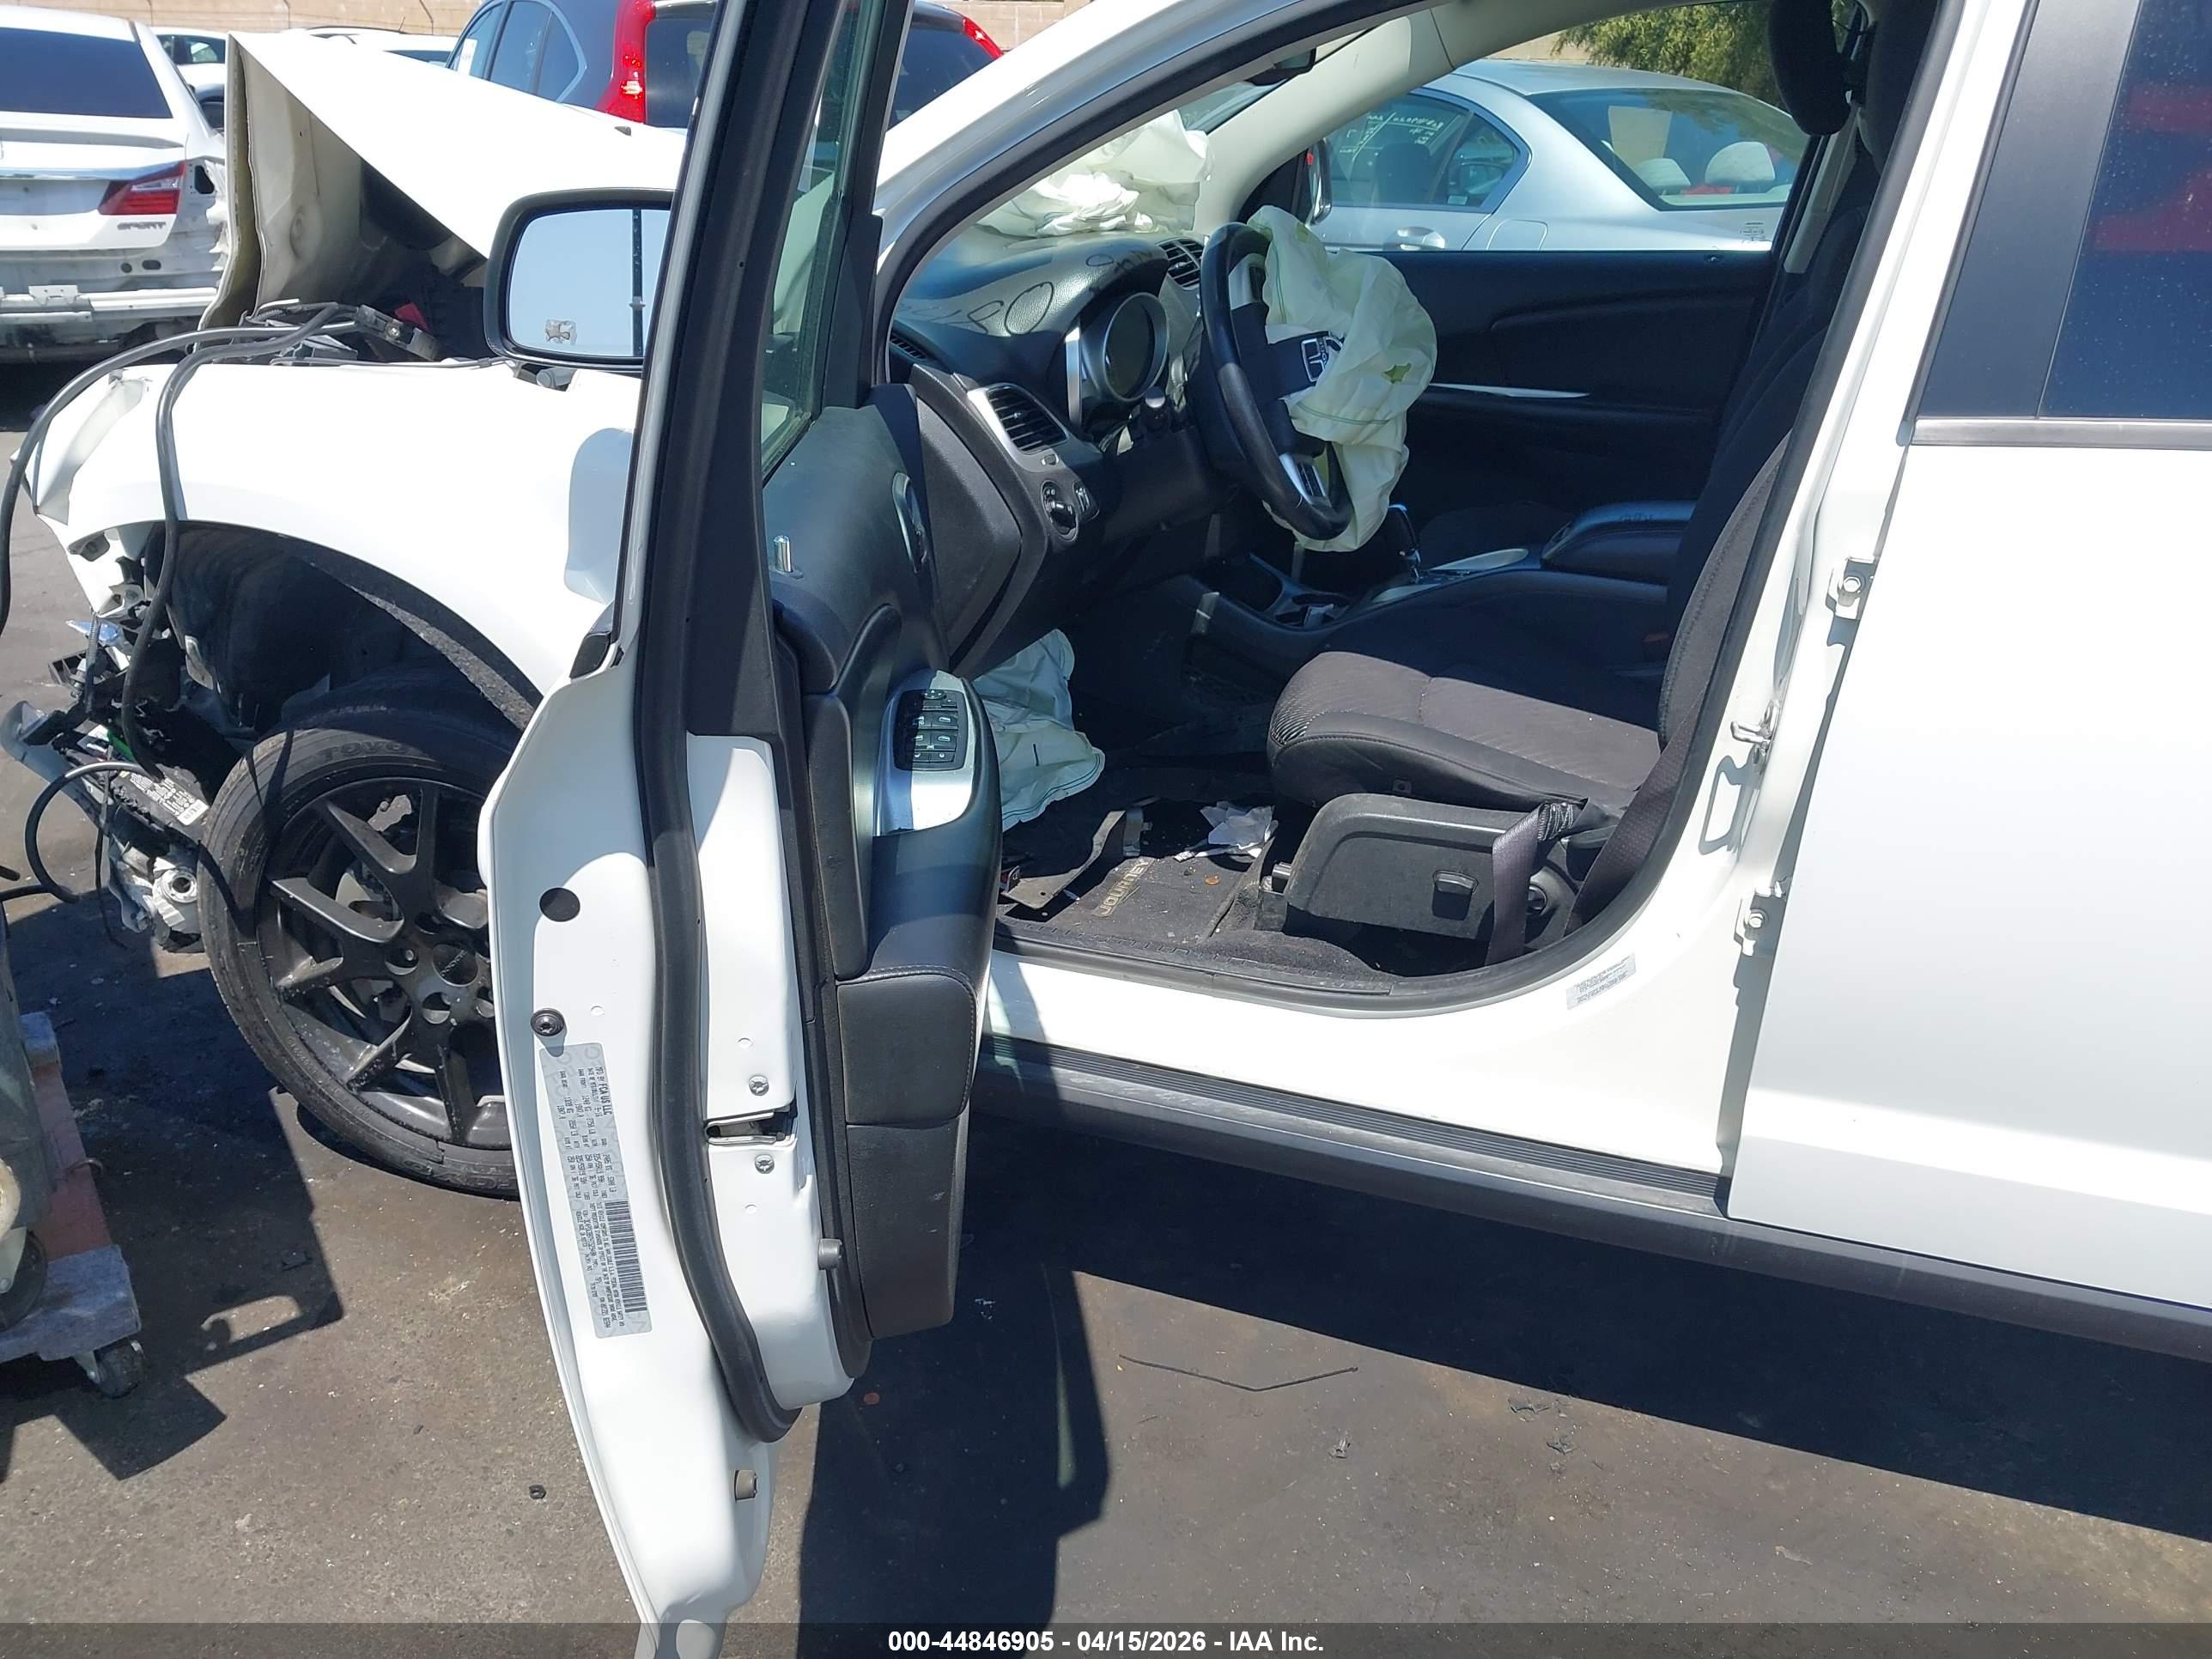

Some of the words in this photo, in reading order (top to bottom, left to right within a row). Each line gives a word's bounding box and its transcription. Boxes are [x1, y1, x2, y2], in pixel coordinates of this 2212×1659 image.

[117, 222, 167, 230] SPORT
[1099, 858, 1149, 915] JOURNEY
[598, 1083, 608, 1094] FCA
[600, 1095, 610, 1103] US
[602, 1104, 612, 1115] LLC
